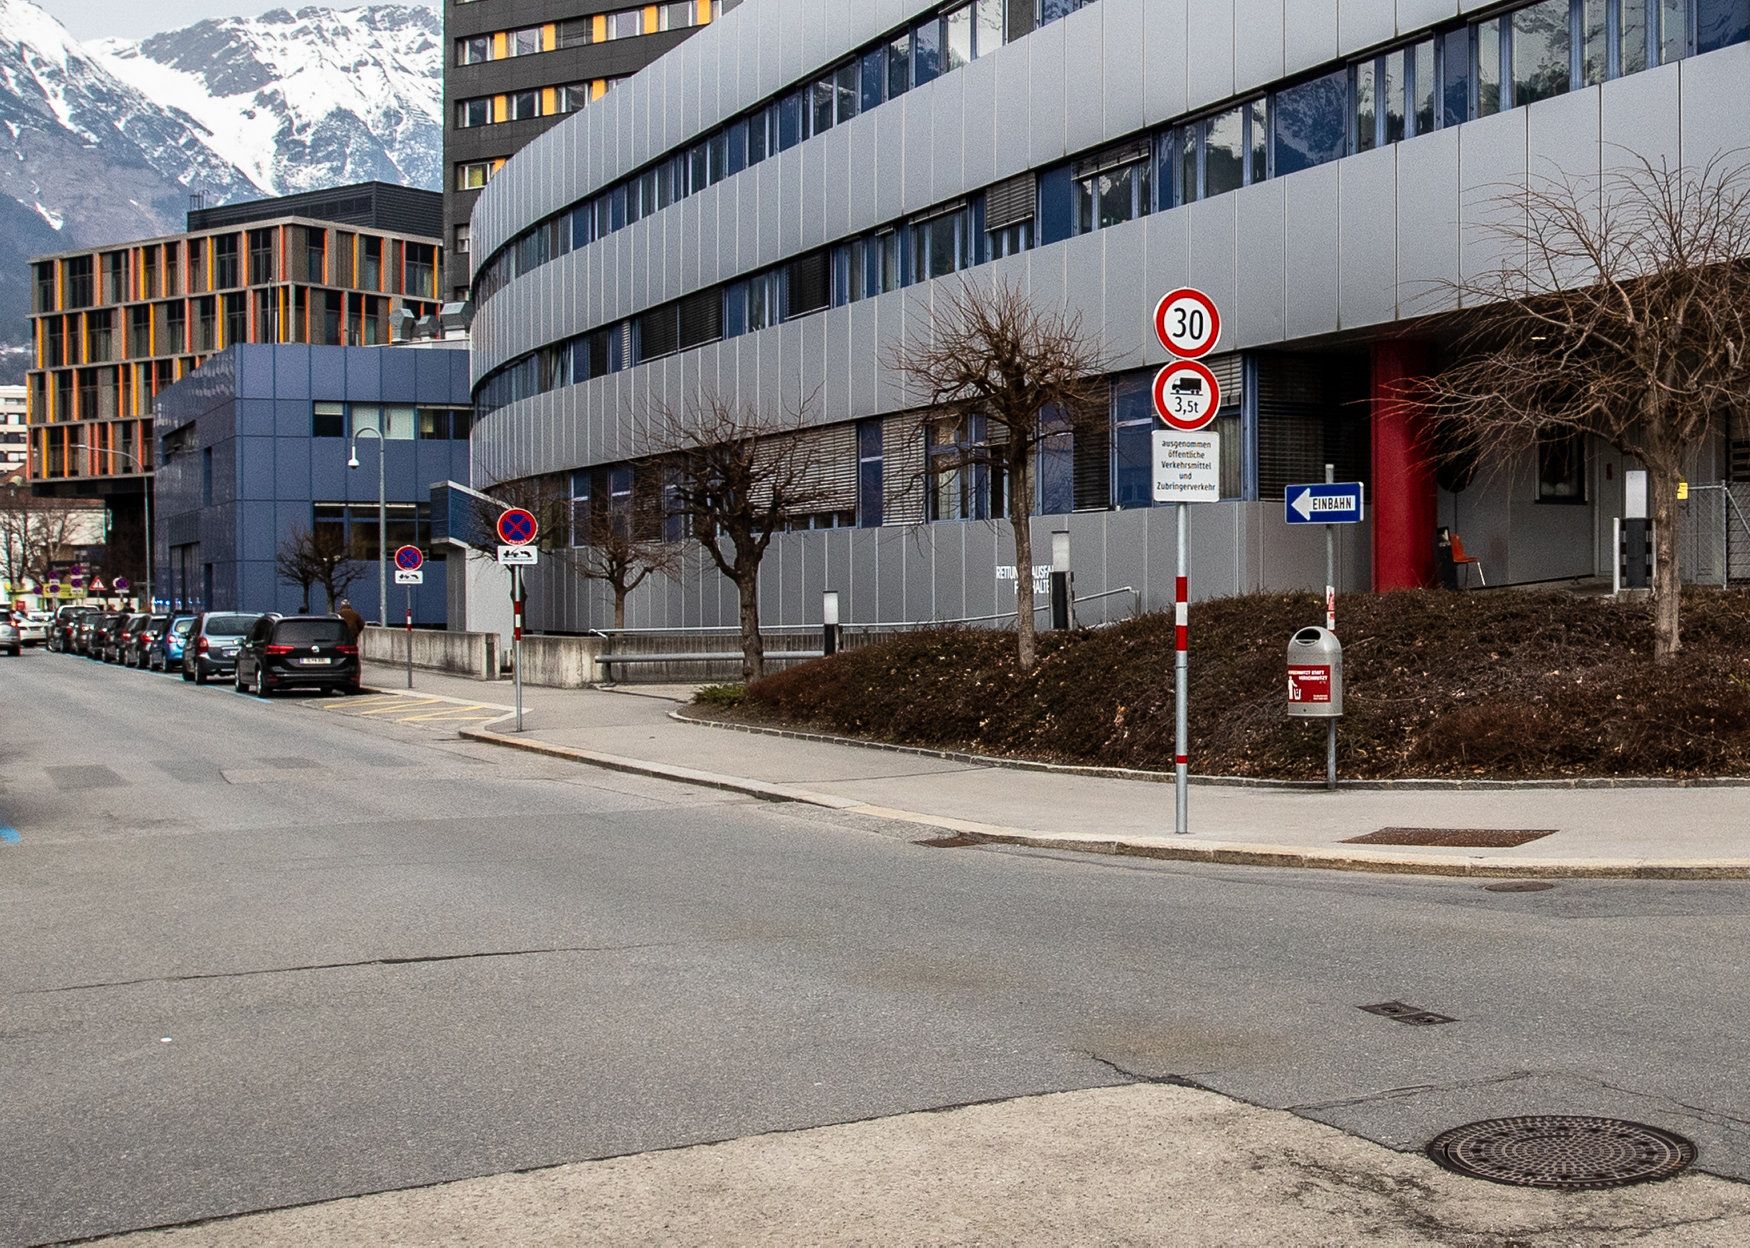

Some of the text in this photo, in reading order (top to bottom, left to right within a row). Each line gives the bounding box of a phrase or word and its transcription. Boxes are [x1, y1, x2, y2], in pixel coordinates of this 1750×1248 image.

[1173, 307, 1204, 340] 30
[1174, 396, 1199, 415] 3,5t
[1161, 440, 1212, 449] ausgenommen
[1167, 449, 1206, 459] öffentliche
[1161, 460, 1212, 470] Verkehrsmittel
[1178, 472, 1193, 481] und
[1156, 481, 1217, 492] Zubringerverkehr
[1312, 496, 1353, 511] EINBAHN
